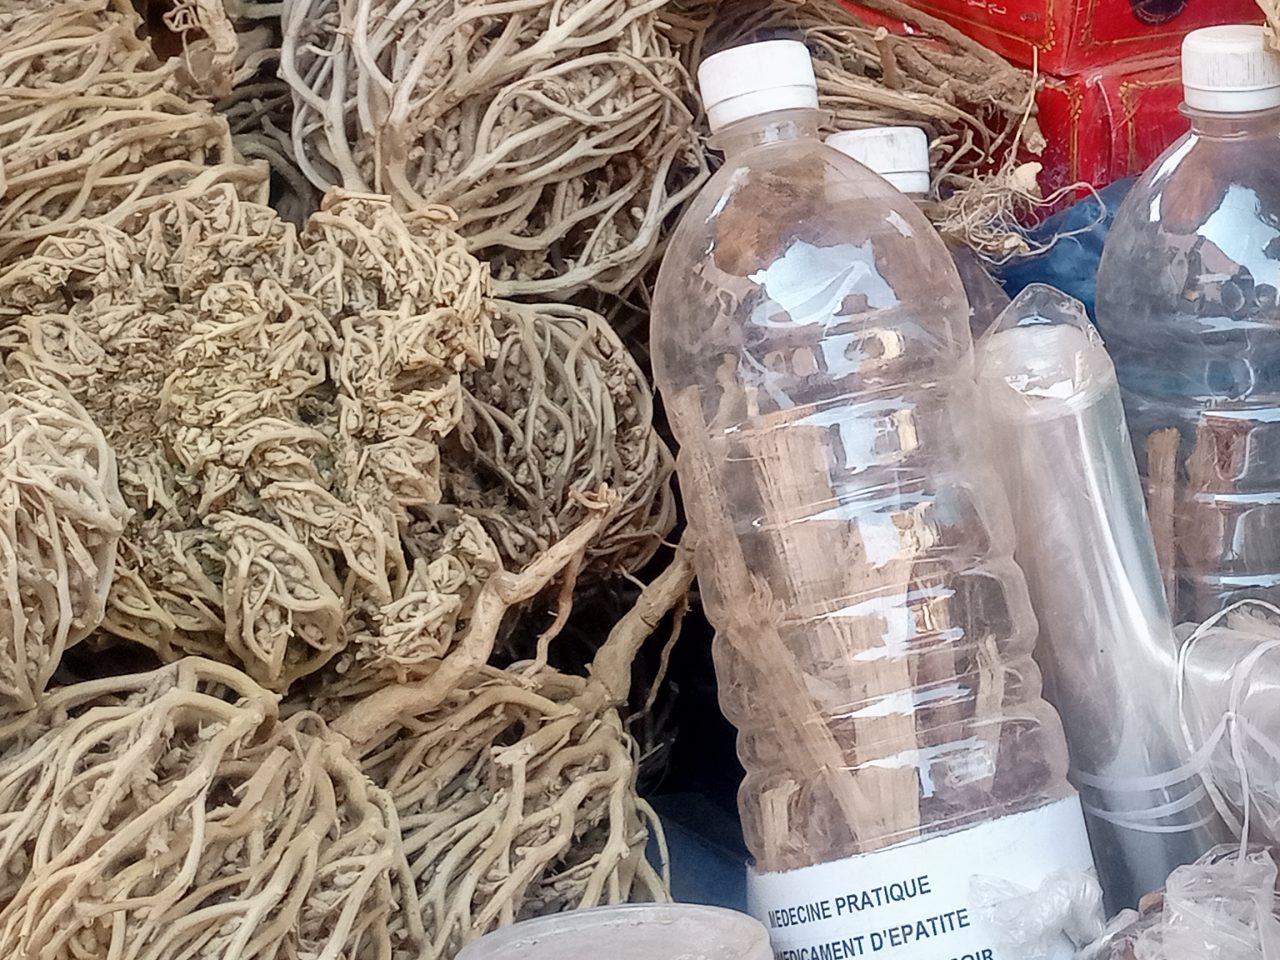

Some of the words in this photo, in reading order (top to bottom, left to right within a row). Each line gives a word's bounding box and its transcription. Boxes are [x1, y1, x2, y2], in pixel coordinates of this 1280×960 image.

[768, 900, 832, 929] MEDECINE
[835, 875, 932, 915] PRATIQUE
[870, 907, 971, 952] D'EPATITE
